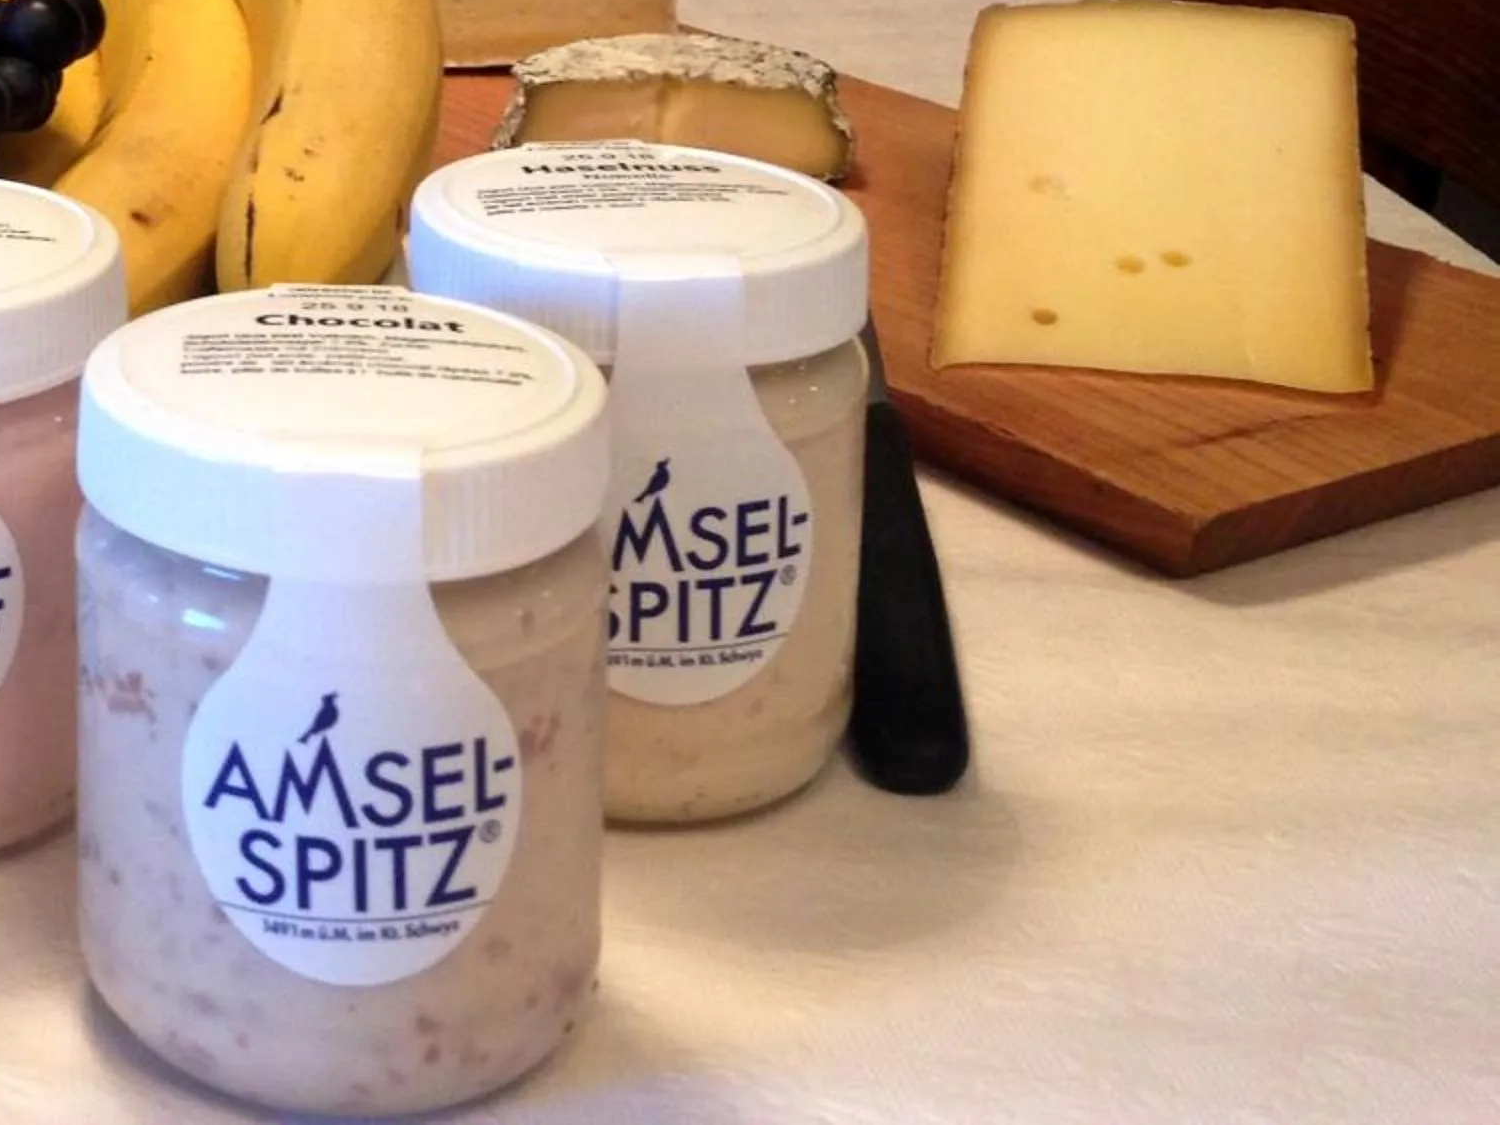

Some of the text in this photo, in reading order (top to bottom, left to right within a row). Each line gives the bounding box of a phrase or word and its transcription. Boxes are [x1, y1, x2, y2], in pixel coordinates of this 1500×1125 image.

[522, 162, 722, 174] Haselnuss
[255, 313, 467, 334] Chocolat
[611, 495, 809, 573] MSEL-
[203, 735, 515, 829] AMSEL-
